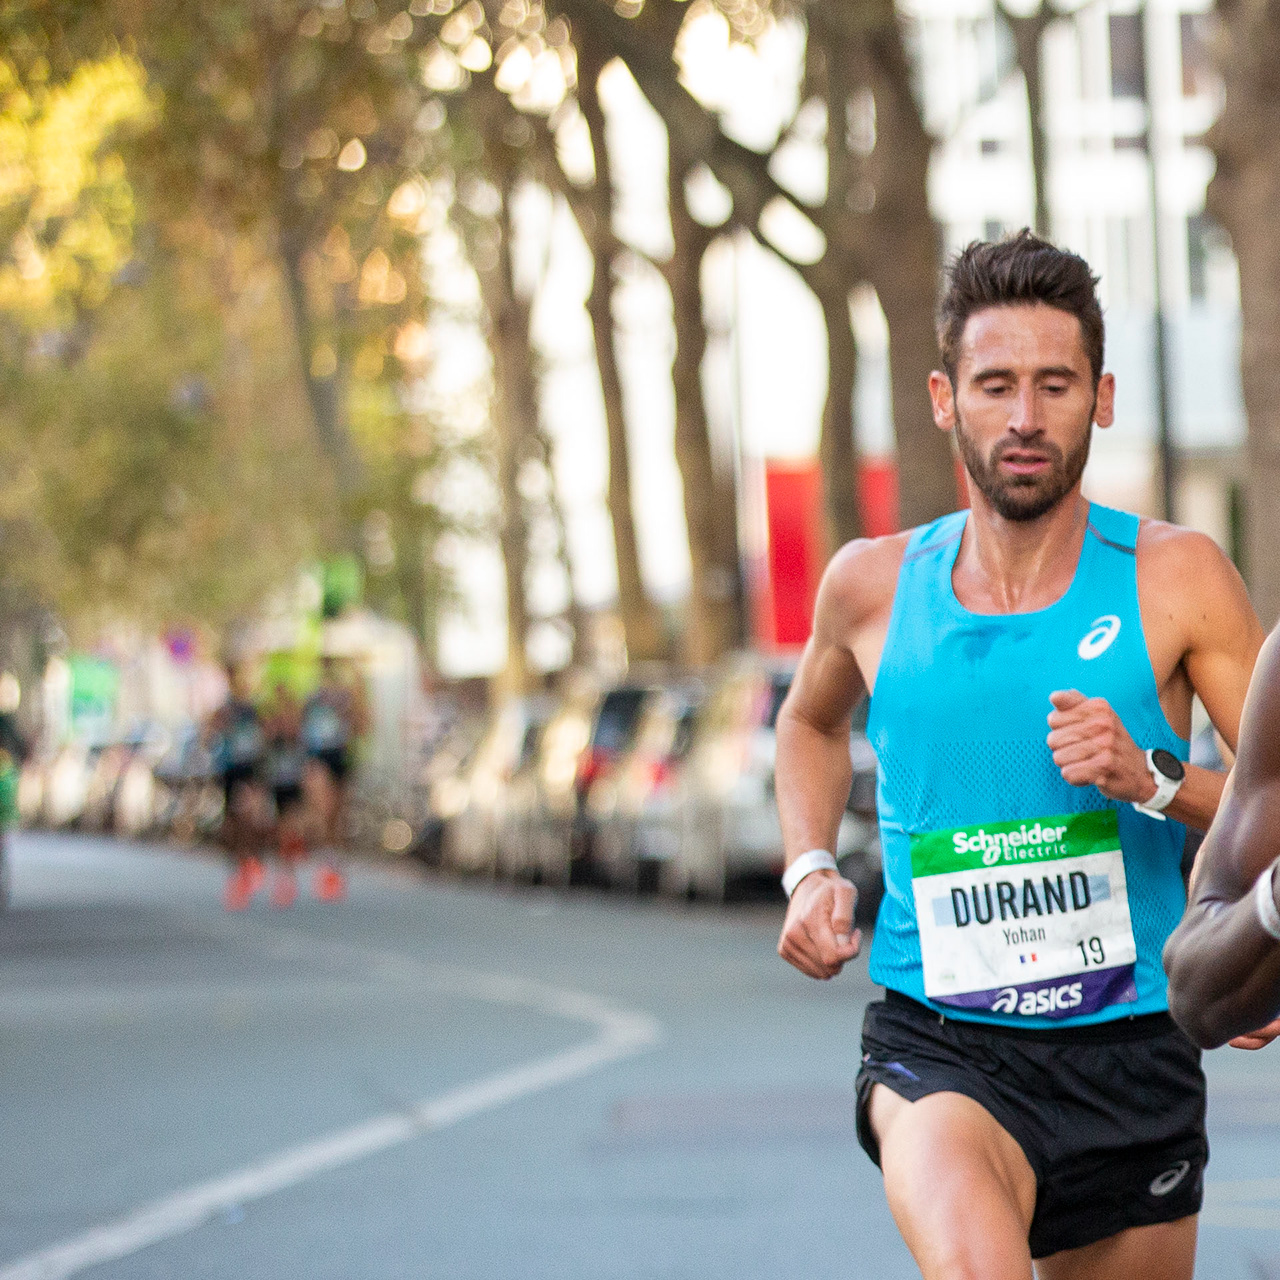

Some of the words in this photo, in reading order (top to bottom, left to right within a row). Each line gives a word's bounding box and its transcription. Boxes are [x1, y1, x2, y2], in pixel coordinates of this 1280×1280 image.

[952, 822, 1068, 855] Schneider
[1002, 842, 1068, 862] Electric
[950, 870, 1092, 928] DURAND
[1003, 926, 1047, 946] Yohan
[1076, 936, 1106, 967] 19
